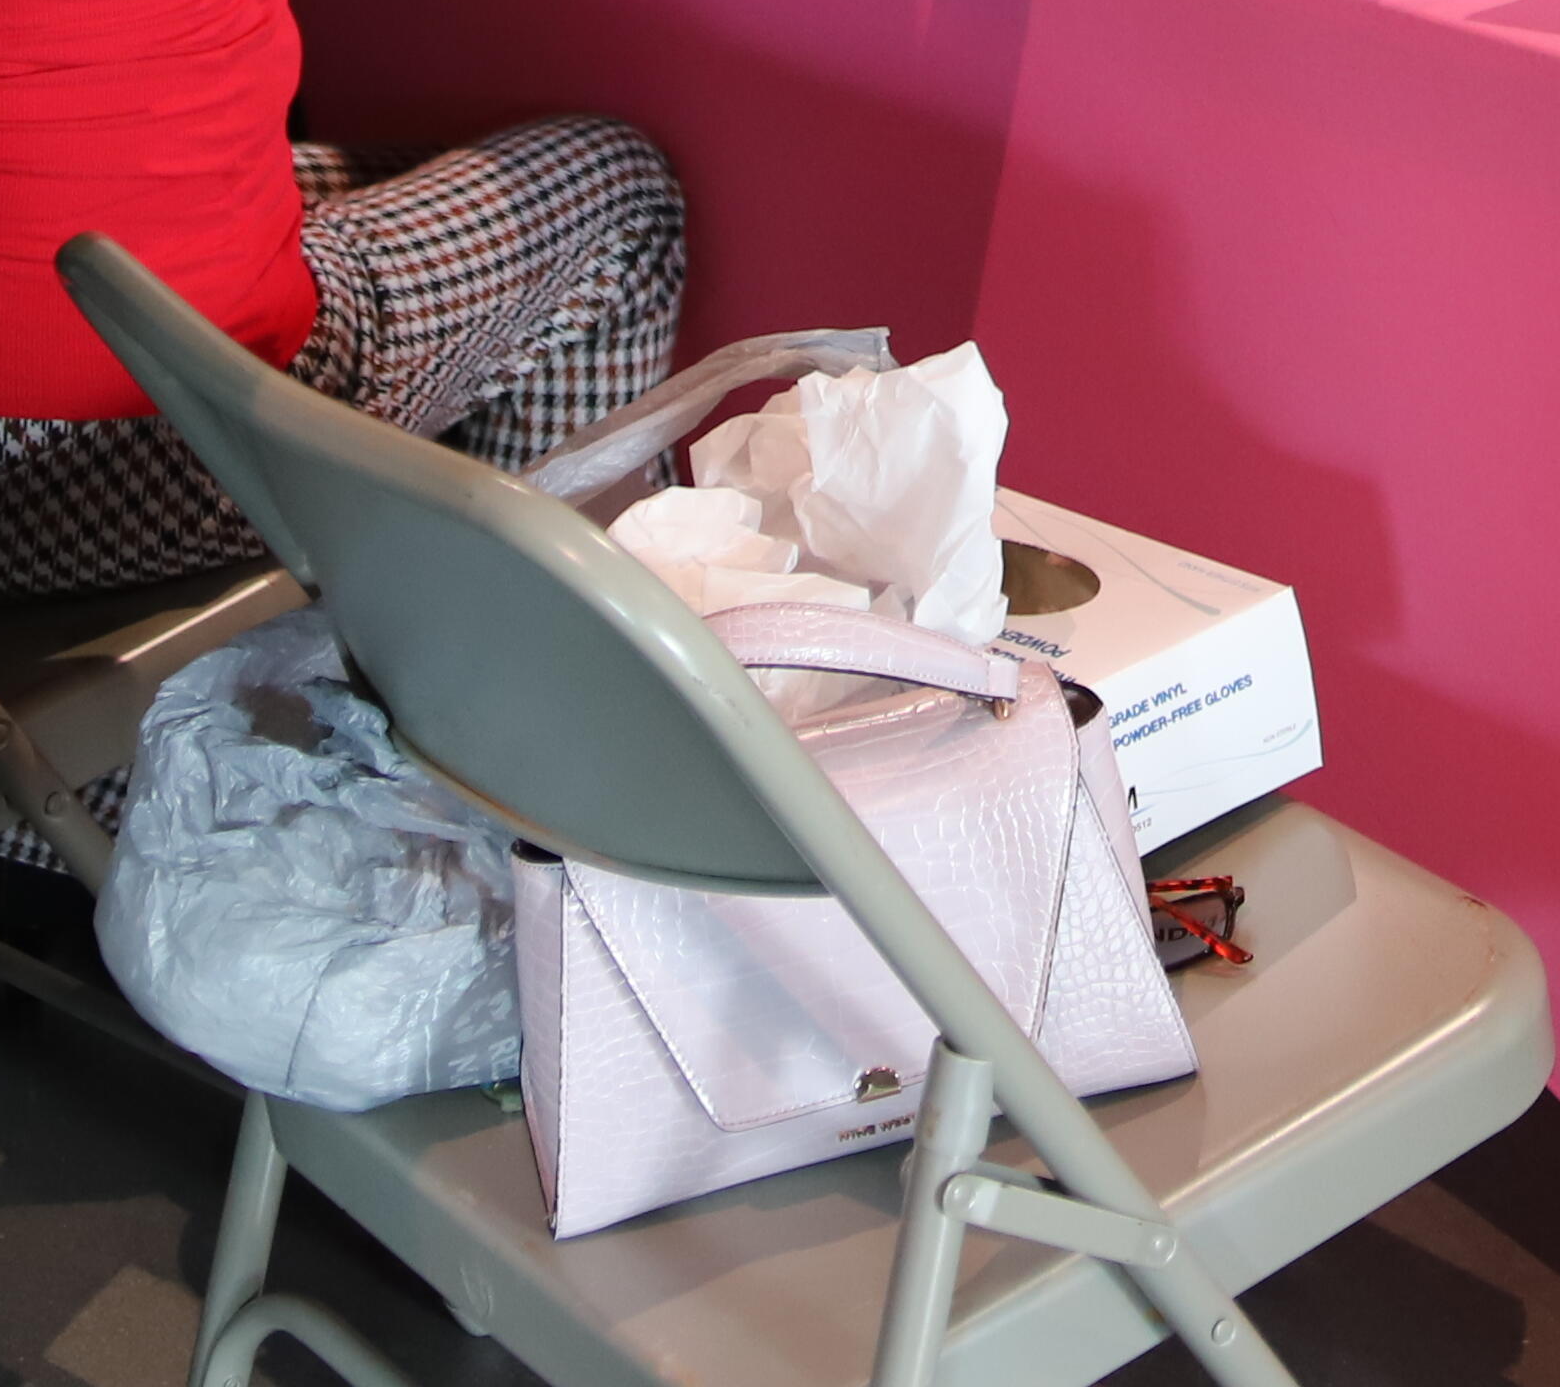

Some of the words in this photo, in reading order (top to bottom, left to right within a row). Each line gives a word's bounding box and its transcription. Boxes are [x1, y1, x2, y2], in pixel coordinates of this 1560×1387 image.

[1113, 698, 1203, 751] POWDER-FREE
[1205, 674, 1253, 707] GLOVES
[1151, 683, 1188, 708] VINYL
